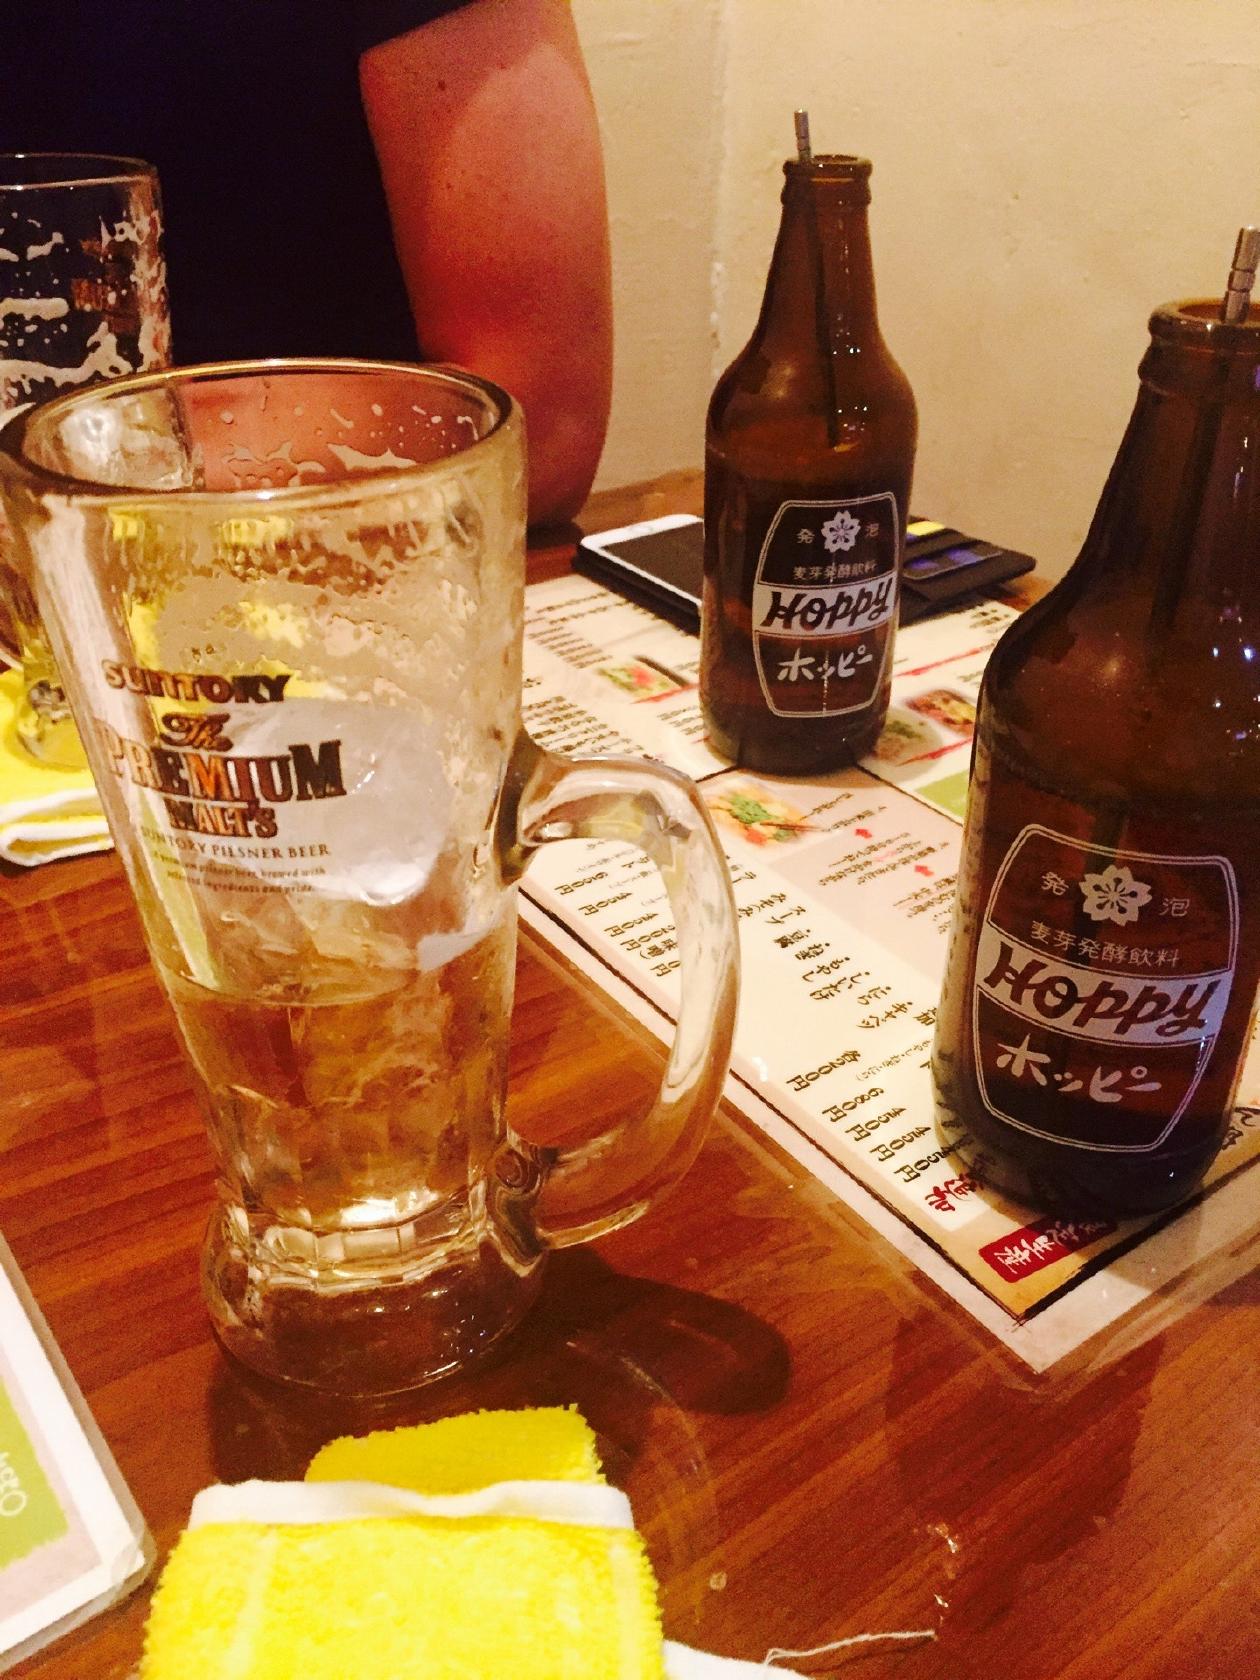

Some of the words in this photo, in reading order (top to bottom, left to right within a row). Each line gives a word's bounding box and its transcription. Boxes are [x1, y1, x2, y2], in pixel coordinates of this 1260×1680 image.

[797, 528, 815, 544] 発
[865, 523, 880, 537] 泡
[760, 577, 893, 631] Hoppy
[777, 644, 873, 682] ホッピー
[102, 660, 292, 704] SUNTORY
[94, 716, 347, 802] PREMIUM
[212, 843, 283, 859] PILSNER
[288, 843, 333, 859] BEER
[1041, 871, 1069, 896] 発
[1159, 898, 1189, 917] 泡
[765, 906, 806, 924] スープ
[1030, 920, 1180, 967] 麦芽発酵飲料
[802, 958, 844, 982] もやし
[809, 973, 862, 1000] しいたけ
[857, 986, 887, 1005] にら
[984, 941, 1221, 1037] Hoppy
[856, 1002, 908, 1028] キャベツ
[913, 1007, 938, 1026] 加
[786, 1050, 861, 1091] 各200円
[996, 1033, 1161, 1103] ホッピー
[822, 1087, 884, 1122] 680円
[845, 1107, 907, 1142] 450円
[869, 1126, 931, 1162] 450円
